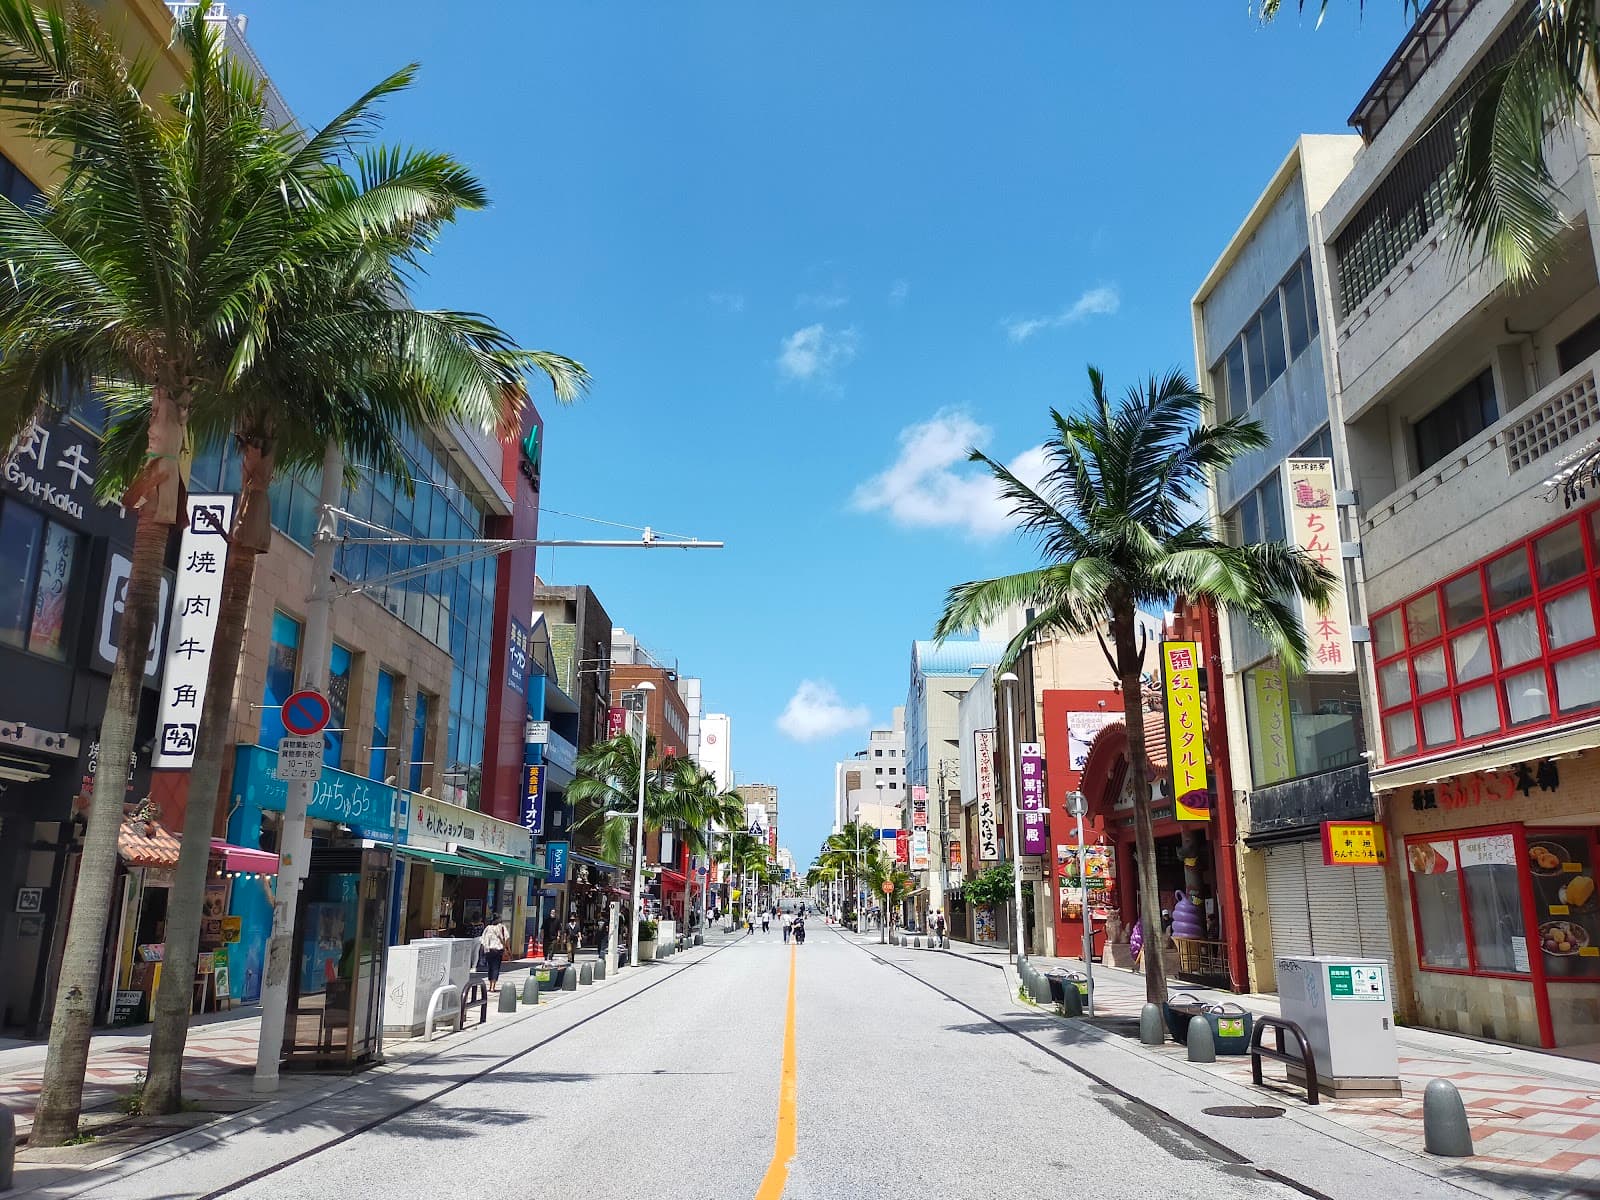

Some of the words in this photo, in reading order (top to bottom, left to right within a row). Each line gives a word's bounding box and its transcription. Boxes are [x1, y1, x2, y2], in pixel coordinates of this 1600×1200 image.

[5, 463, 83, 519] Gyu-Kaku
[171, 551, 216, 708] 焼肉牛角
[1171, 651, 1192, 670] 元祖
[1171, 674, 1199, 787] 紅いもタルト
[980, 802, 996, 856] あかはち
